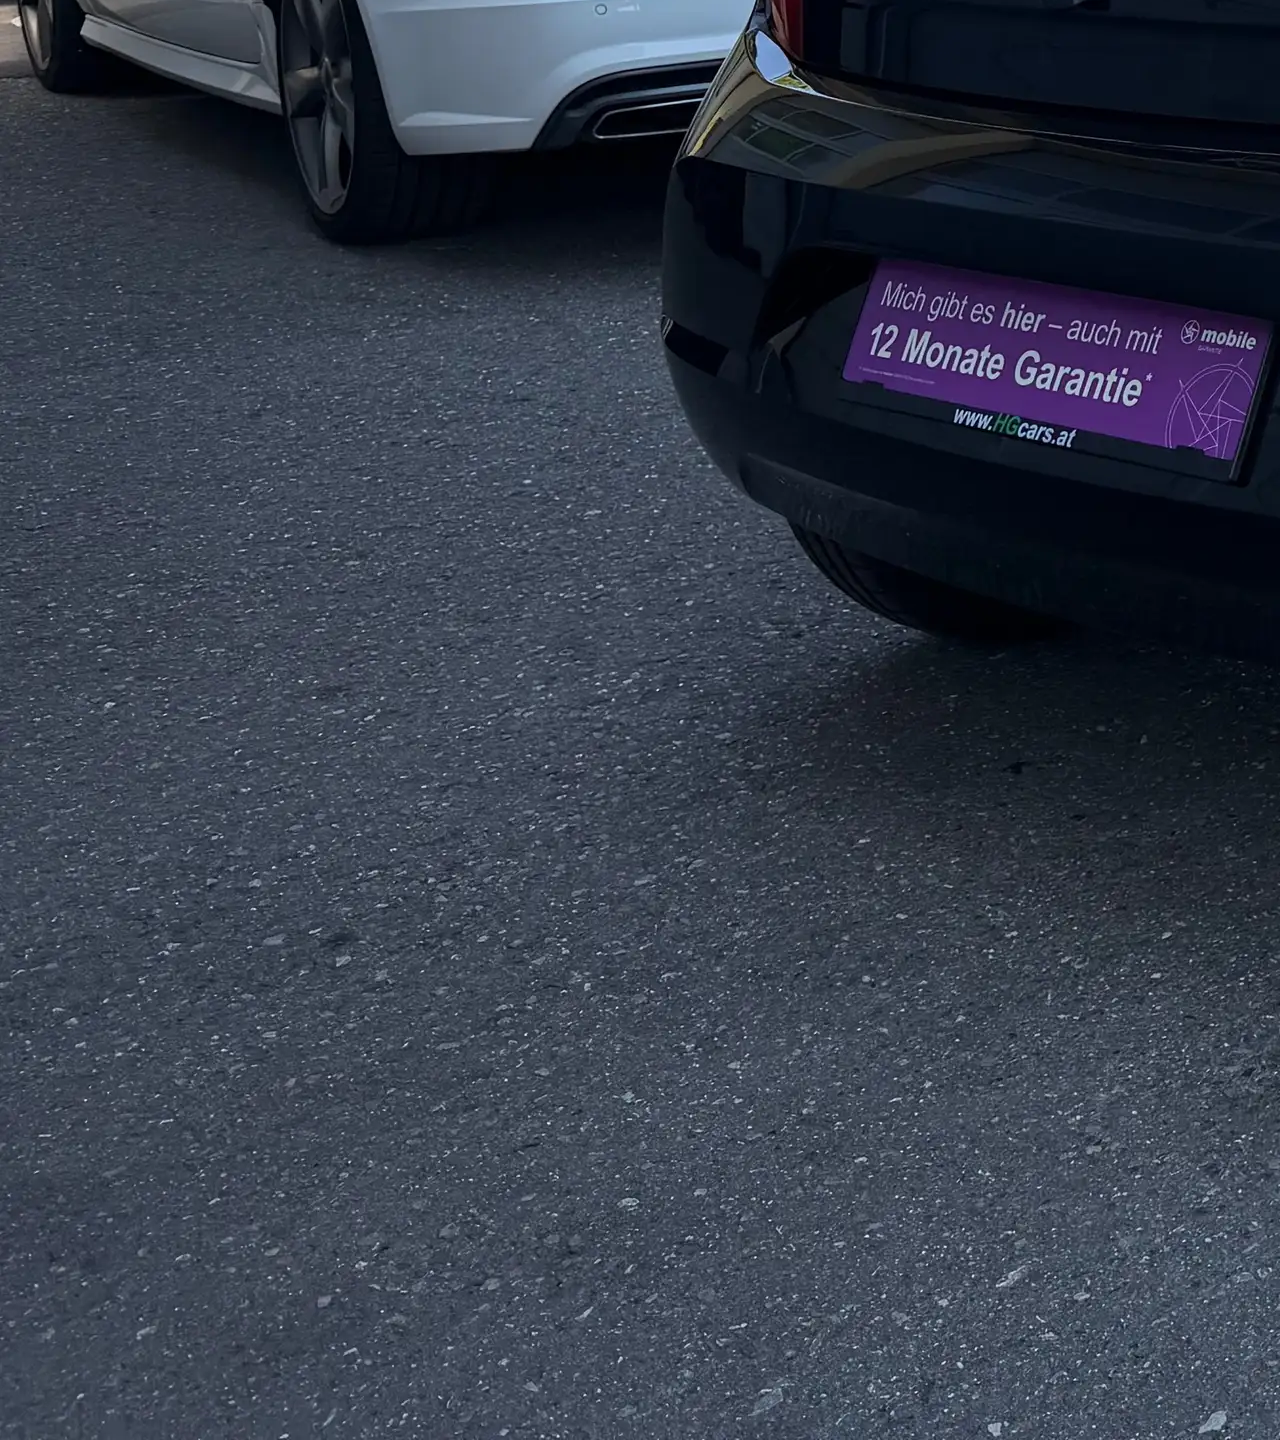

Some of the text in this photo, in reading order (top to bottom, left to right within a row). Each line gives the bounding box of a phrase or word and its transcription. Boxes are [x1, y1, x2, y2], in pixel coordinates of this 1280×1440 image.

[881, 280, 927, 312] Mich
[927, 291, 969, 321] gibt
[970, 302, 995, 325] es
[1000, 301, 1046, 333] hier
[1066, 319, 1121, 347] auch
[1125, 326, 1163, 355] mit
[1200, 329, 1257, 350] mobile
[870, 322, 899, 359] 12
[901, 328, 1005, 380] Monate
[953, 408, 1078, 448] www.HGcars.at
